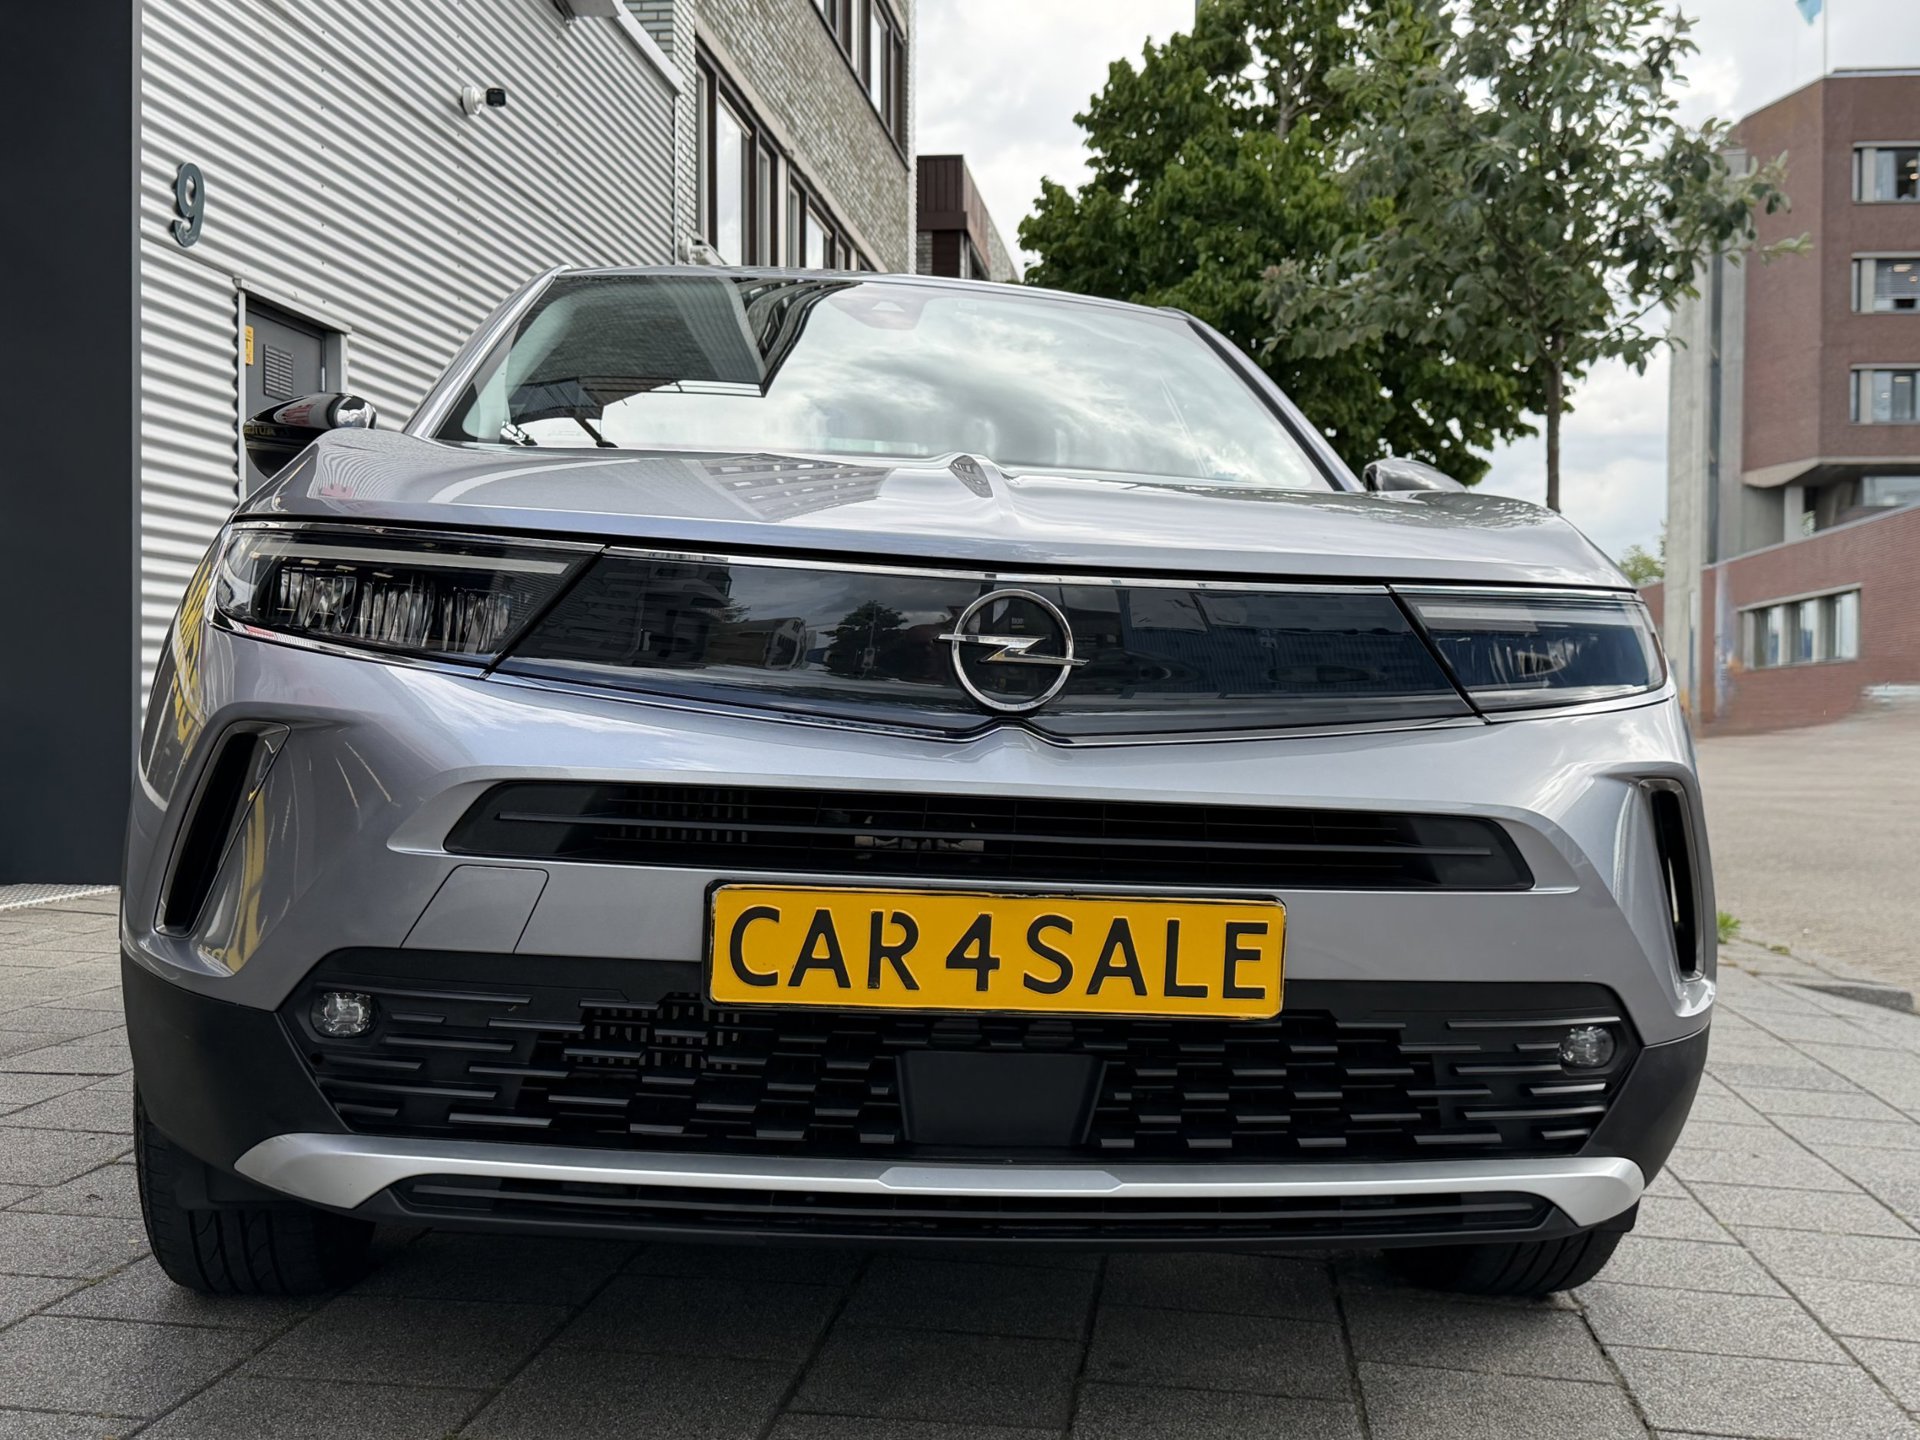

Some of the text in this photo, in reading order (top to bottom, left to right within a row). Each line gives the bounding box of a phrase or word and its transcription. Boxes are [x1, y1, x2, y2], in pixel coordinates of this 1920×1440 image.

[174, 162, 205, 248] 9
[729, 906, 1269, 1000] CAR 4 SALE
